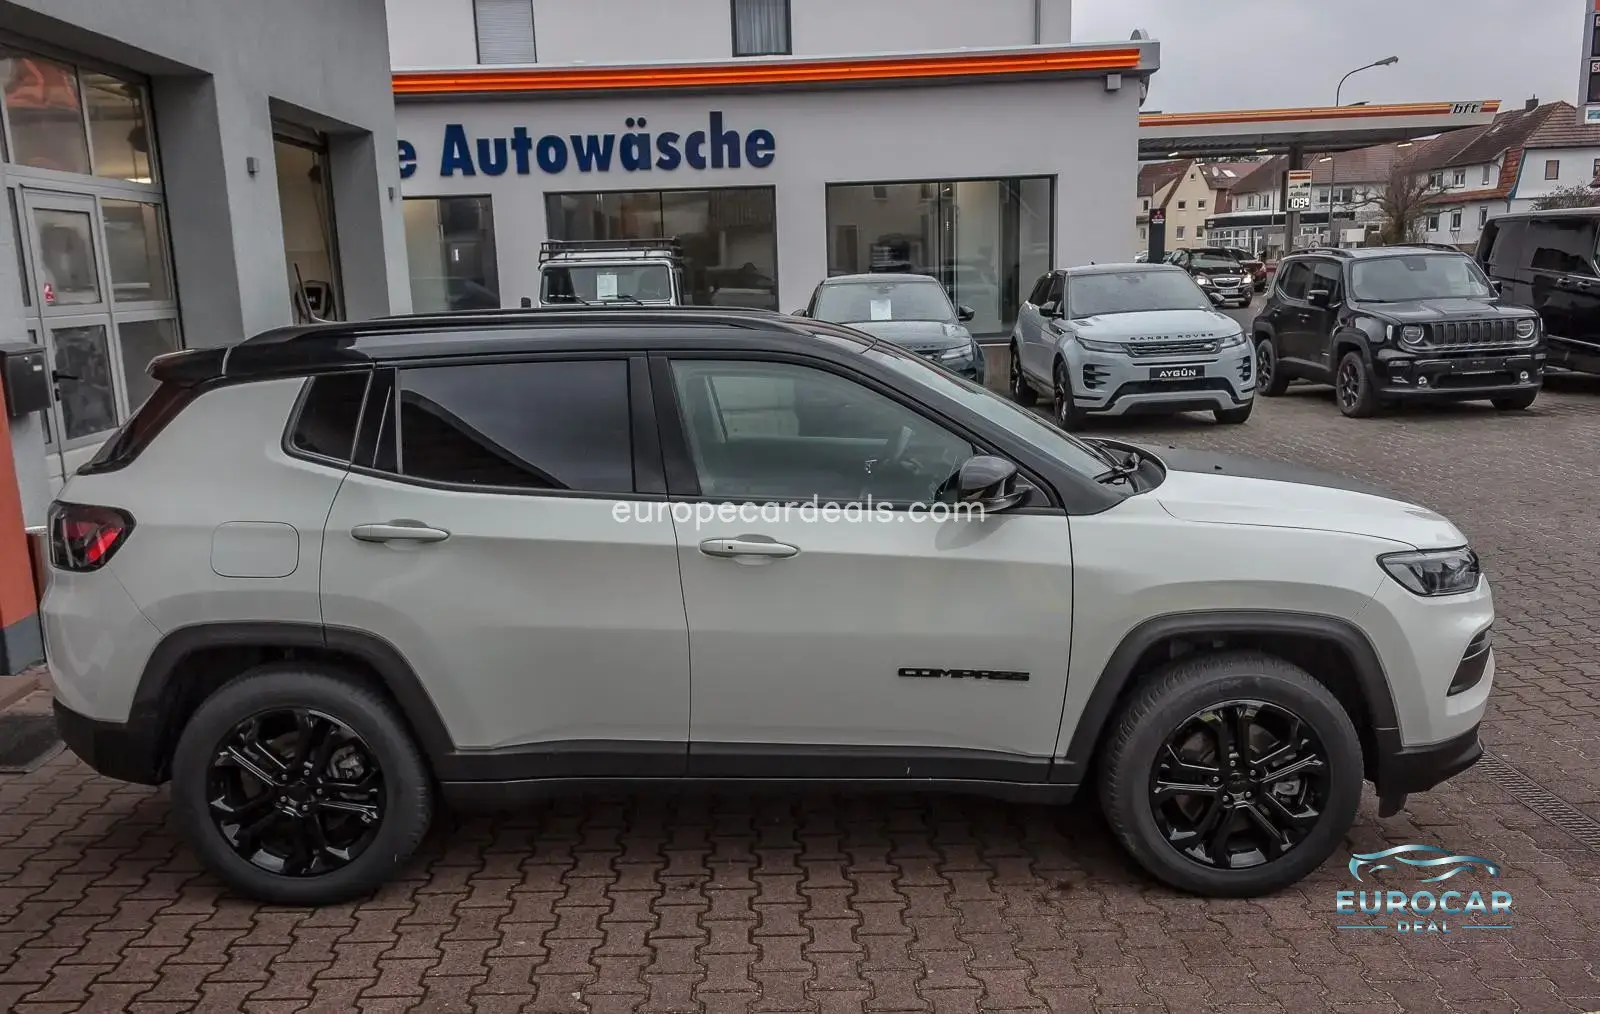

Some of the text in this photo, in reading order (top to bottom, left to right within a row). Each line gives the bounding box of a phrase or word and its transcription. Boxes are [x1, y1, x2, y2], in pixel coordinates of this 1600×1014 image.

[1452, 103, 1479, 114] bft
[440, 111, 776, 177] Autowäsche
[1159, 368, 1197, 378] AYGÜN
[898, 667, 1030, 682] COMPASS
